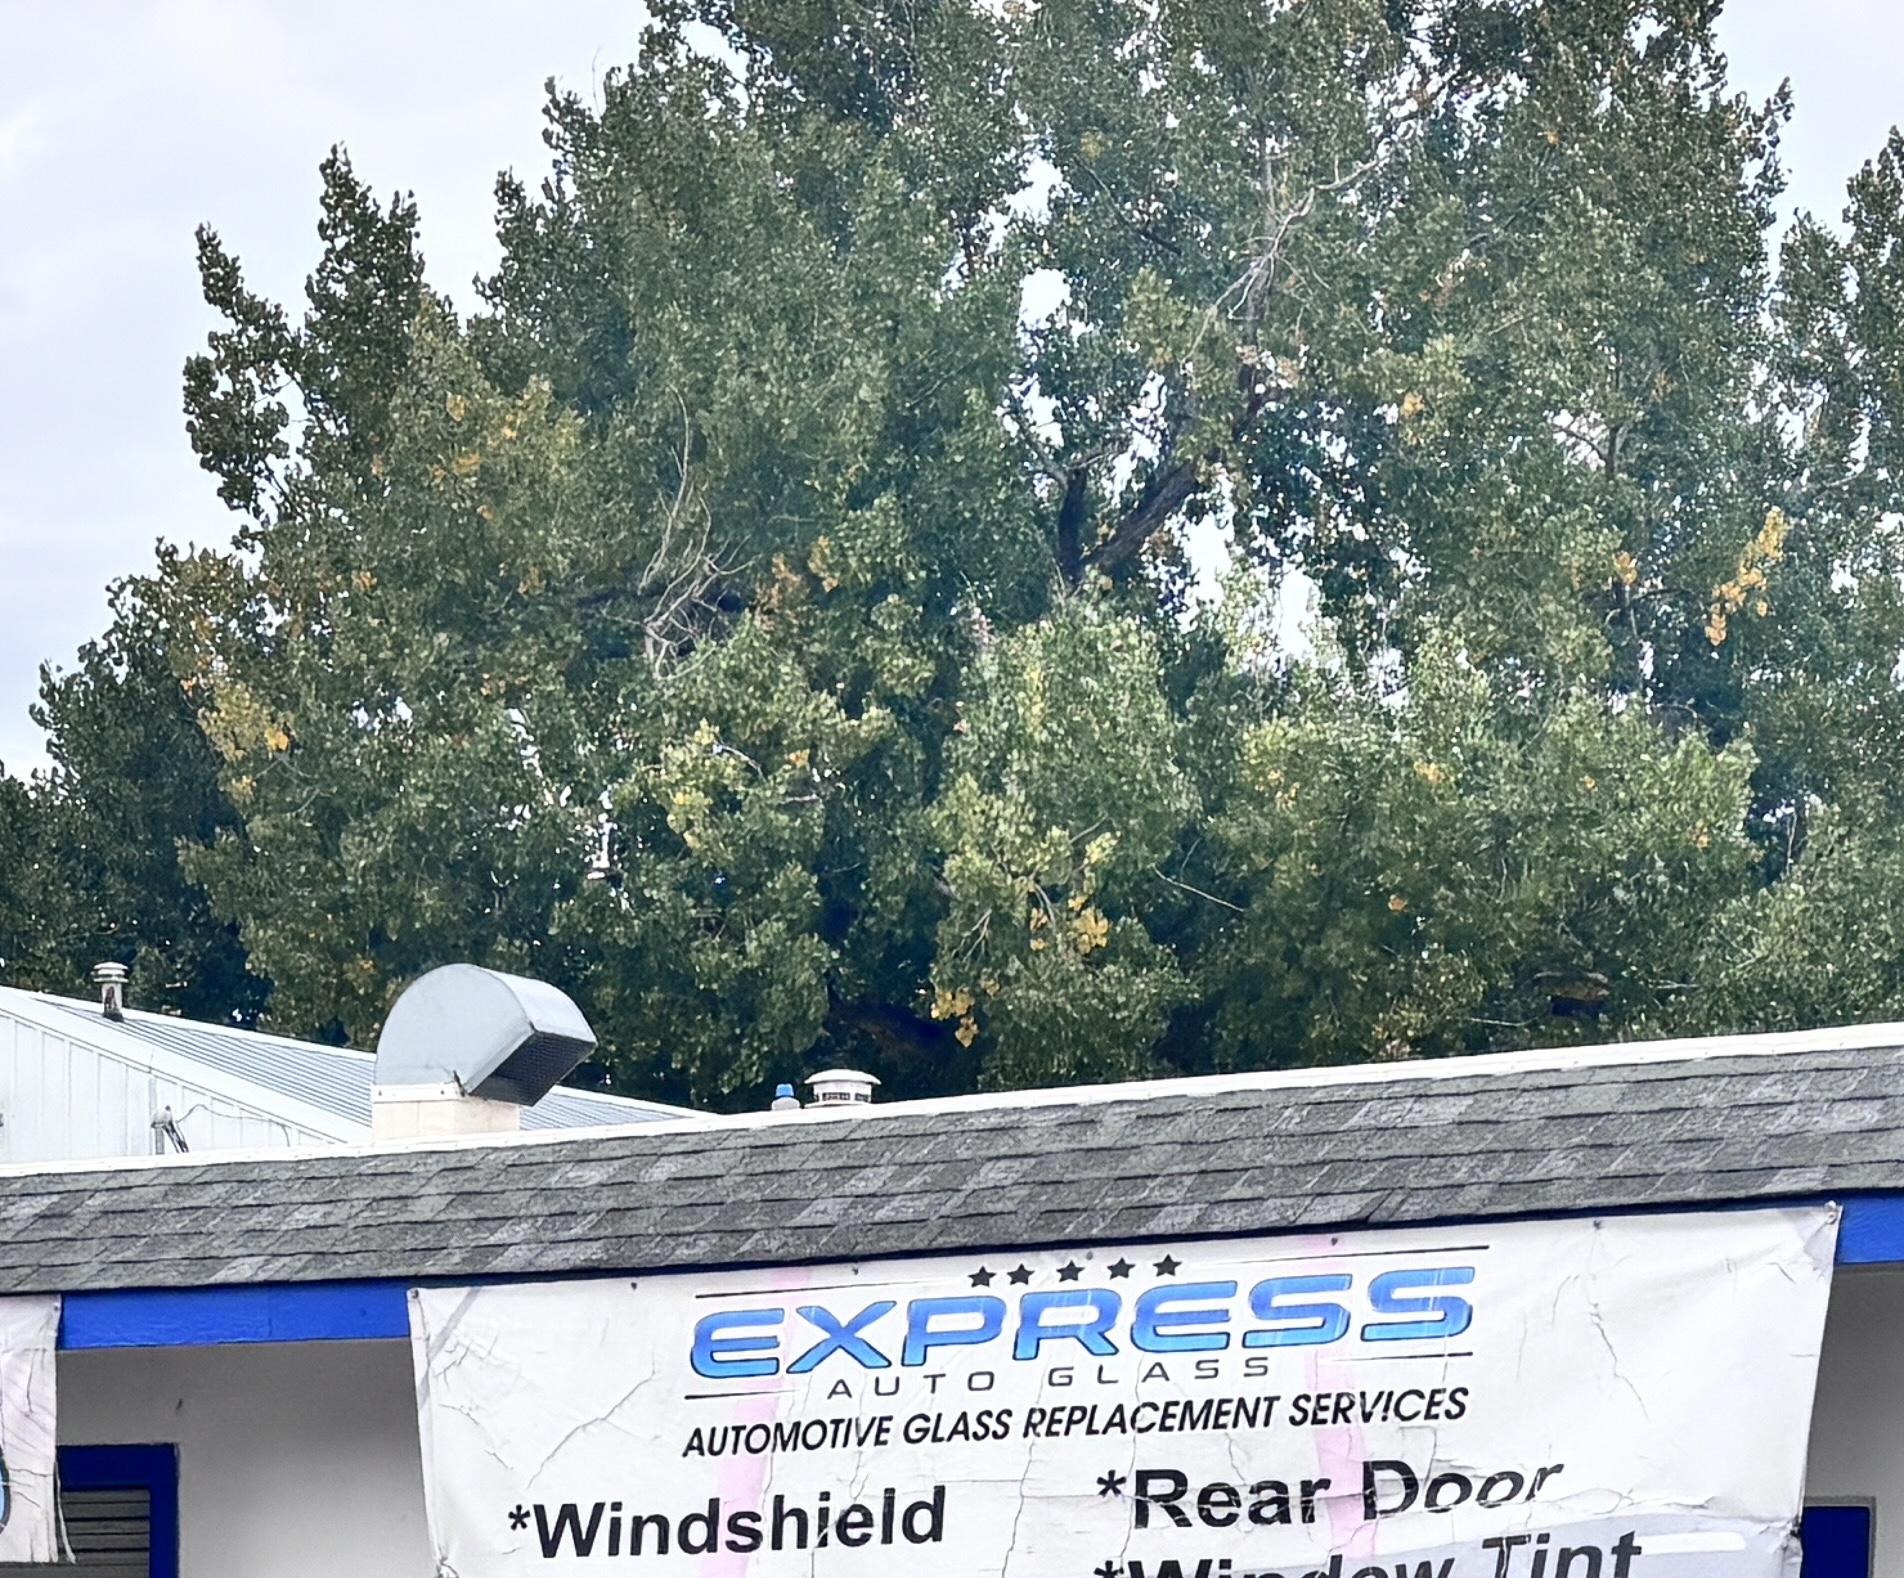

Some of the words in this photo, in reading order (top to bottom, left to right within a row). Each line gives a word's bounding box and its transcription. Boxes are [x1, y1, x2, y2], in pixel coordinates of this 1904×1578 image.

[689, 1265, 1476, 1380] EXPRESS
[825, 1369, 995, 1401] AUTO
[1047, 1356, 1270, 1389] GLASS
[681, 1413, 893, 1459] AUTOMOTIVE
[902, 1406, 1011, 1444] GLASS
[1022, 1394, 1282, 1440] REPLACEMENT
[1288, 1386, 1471, 1428] SERVICES
[1361, 1459, 1566, 1522] Door
